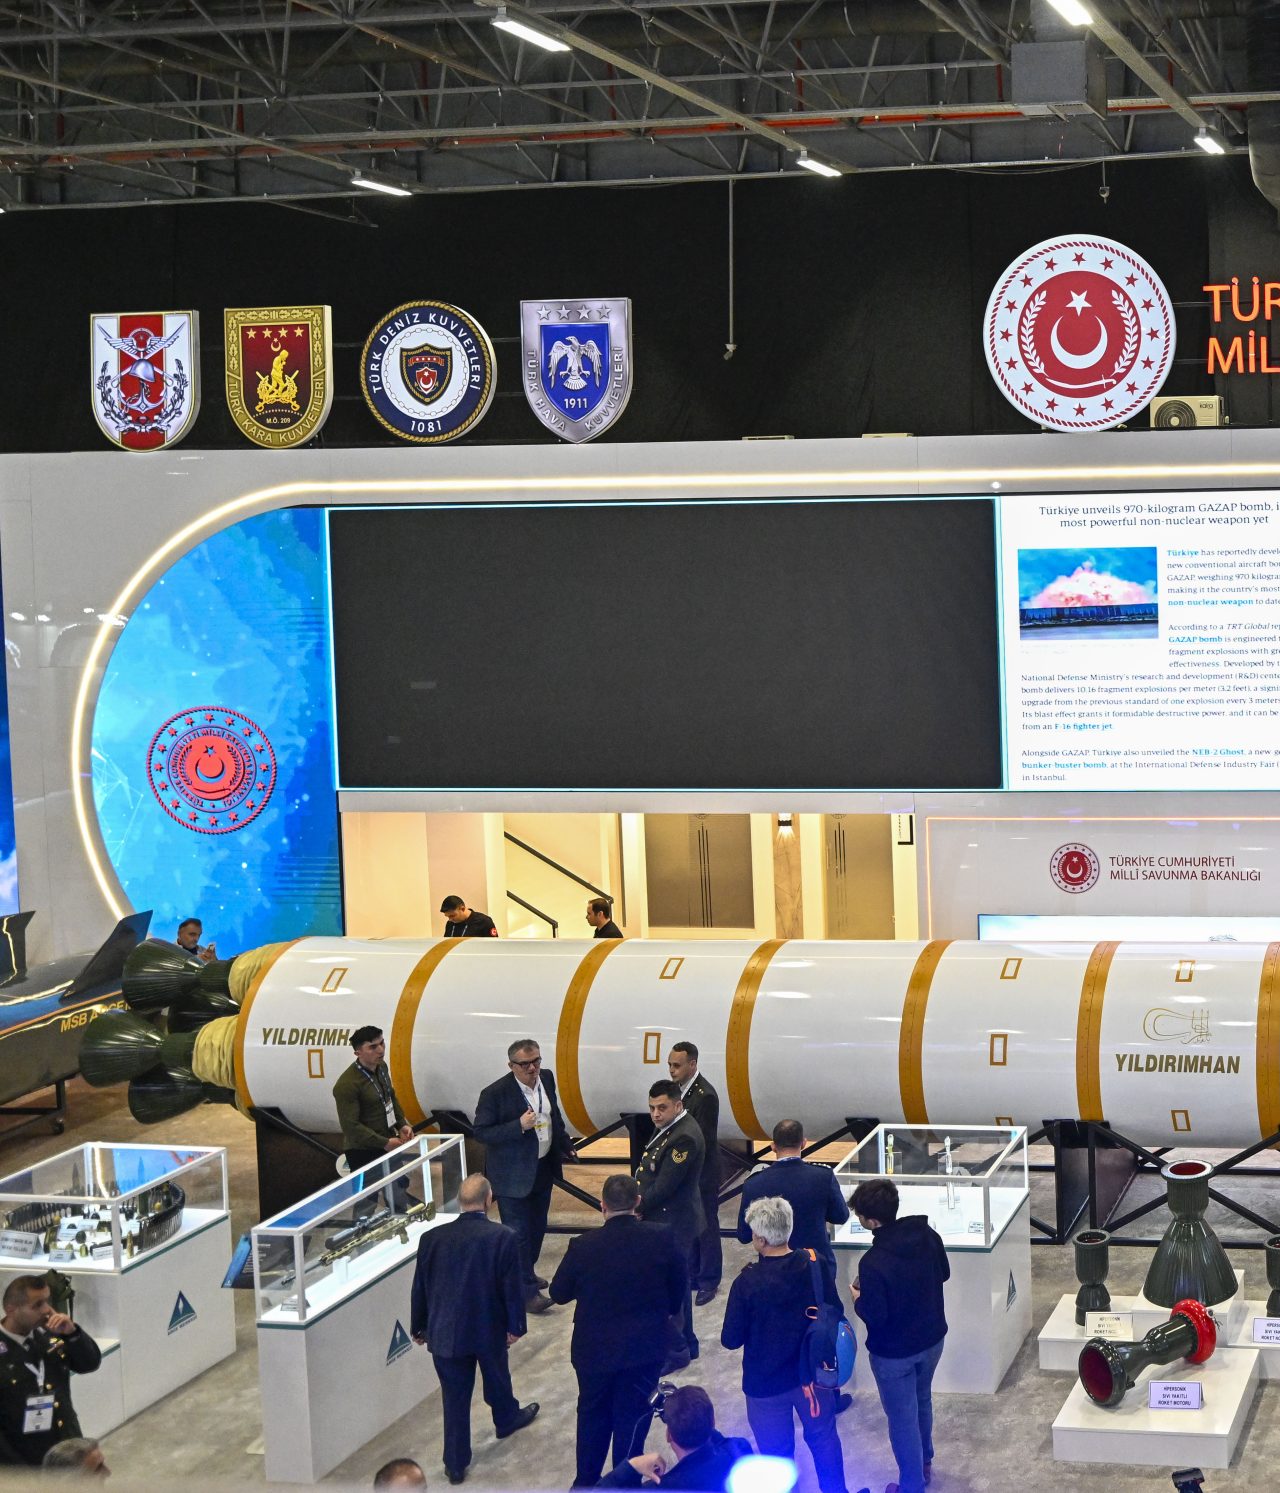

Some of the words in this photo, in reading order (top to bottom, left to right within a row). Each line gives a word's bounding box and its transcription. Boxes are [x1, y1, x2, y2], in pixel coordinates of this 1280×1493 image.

[369, 352, 382, 393] TÜRK
[380, 313, 420, 345] DENİZ
[528, 350, 538, 393] TÜRK
[536, 398, 565, 431] HAVA
[564, 398, 587, 408] 1911
[229, 382, 244, 417] TÜRK
[242, 420, 272, 442] KARA
[411, 420, 441, 432] 1081
[1039, 506, 1079, 516] Türkiye
[1083, 505, 1120, 514] unveils
[1124, 503, 1195, 514] 970-kilogram
[1198, 503, 1237, 512] GAZAP
[1240, 502, 1273, 512] bomb,
[1060, 518, 1086, 527] most
[1090, 517, 1136, 528] powerful
[1140, 516, 1205, 526] non-nuclear
[1209, 516, 1250, 526] weapon
[1253, 515, 1268, 525] yet
[1198, 573, 1233, 581] weighing
[1206, 648, 1248, 656] explosions
[1073, 723, 1100, 731] fighter
[1109, 855, 1154, 867] TÜRKİYE
[1158, 856, 1235, 867] CUMHURİYETİ
[1142, 871, 1197, 880] SAVUNMA
[1201, 870, 1261, 881] BAKANLIĞI
[61, 1013, 87, 1032] MSB
[263, 1028, 352, 1046] YILDIRIMH
[1116, 1054, 1240, 1073] YILDIRIMHAN
